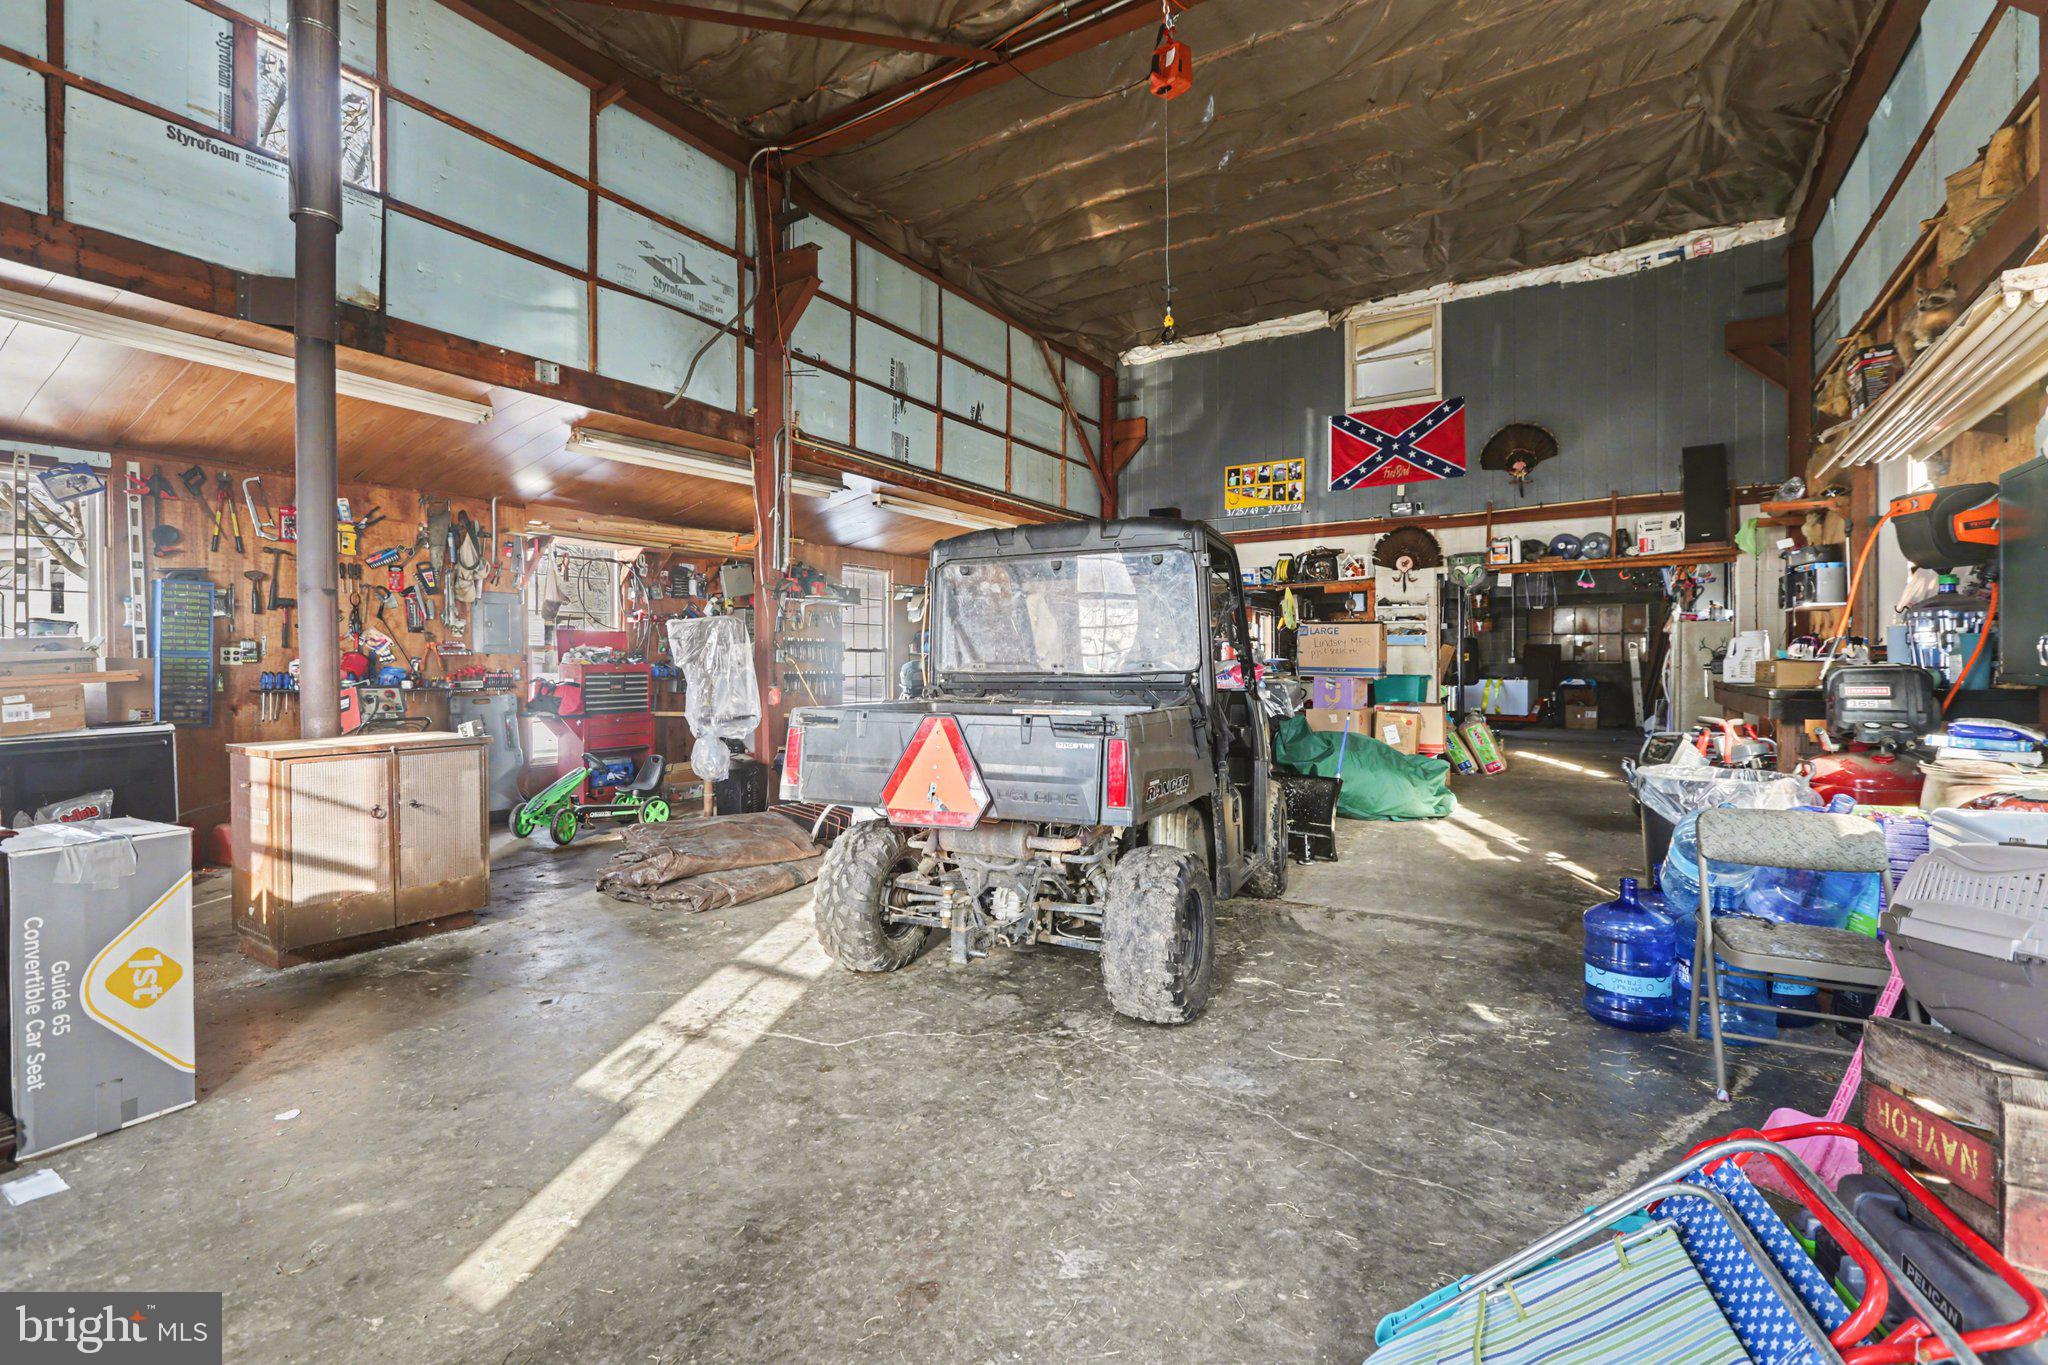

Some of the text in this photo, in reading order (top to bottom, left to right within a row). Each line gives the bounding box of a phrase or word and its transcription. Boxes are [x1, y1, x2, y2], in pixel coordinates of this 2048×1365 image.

[215, 32, 233, 90] Styrofoam
[166, 125, 240, 163] Styrofoam
[652, 275, 694, 302] Styrofoam
[1227, 507, 1258, 517] 3/25/49
[1309, 626, 1339, 635] LARGE
[1146, 774, 1190, 802] RANGER
[50, 960, 71, 1036] Guide 65
[128, 954, 164, 1001] 1st
[23, 916, 46, 1092] Convertible Car Seat
[1906, 1262, 1959, 1326] PELICAN
